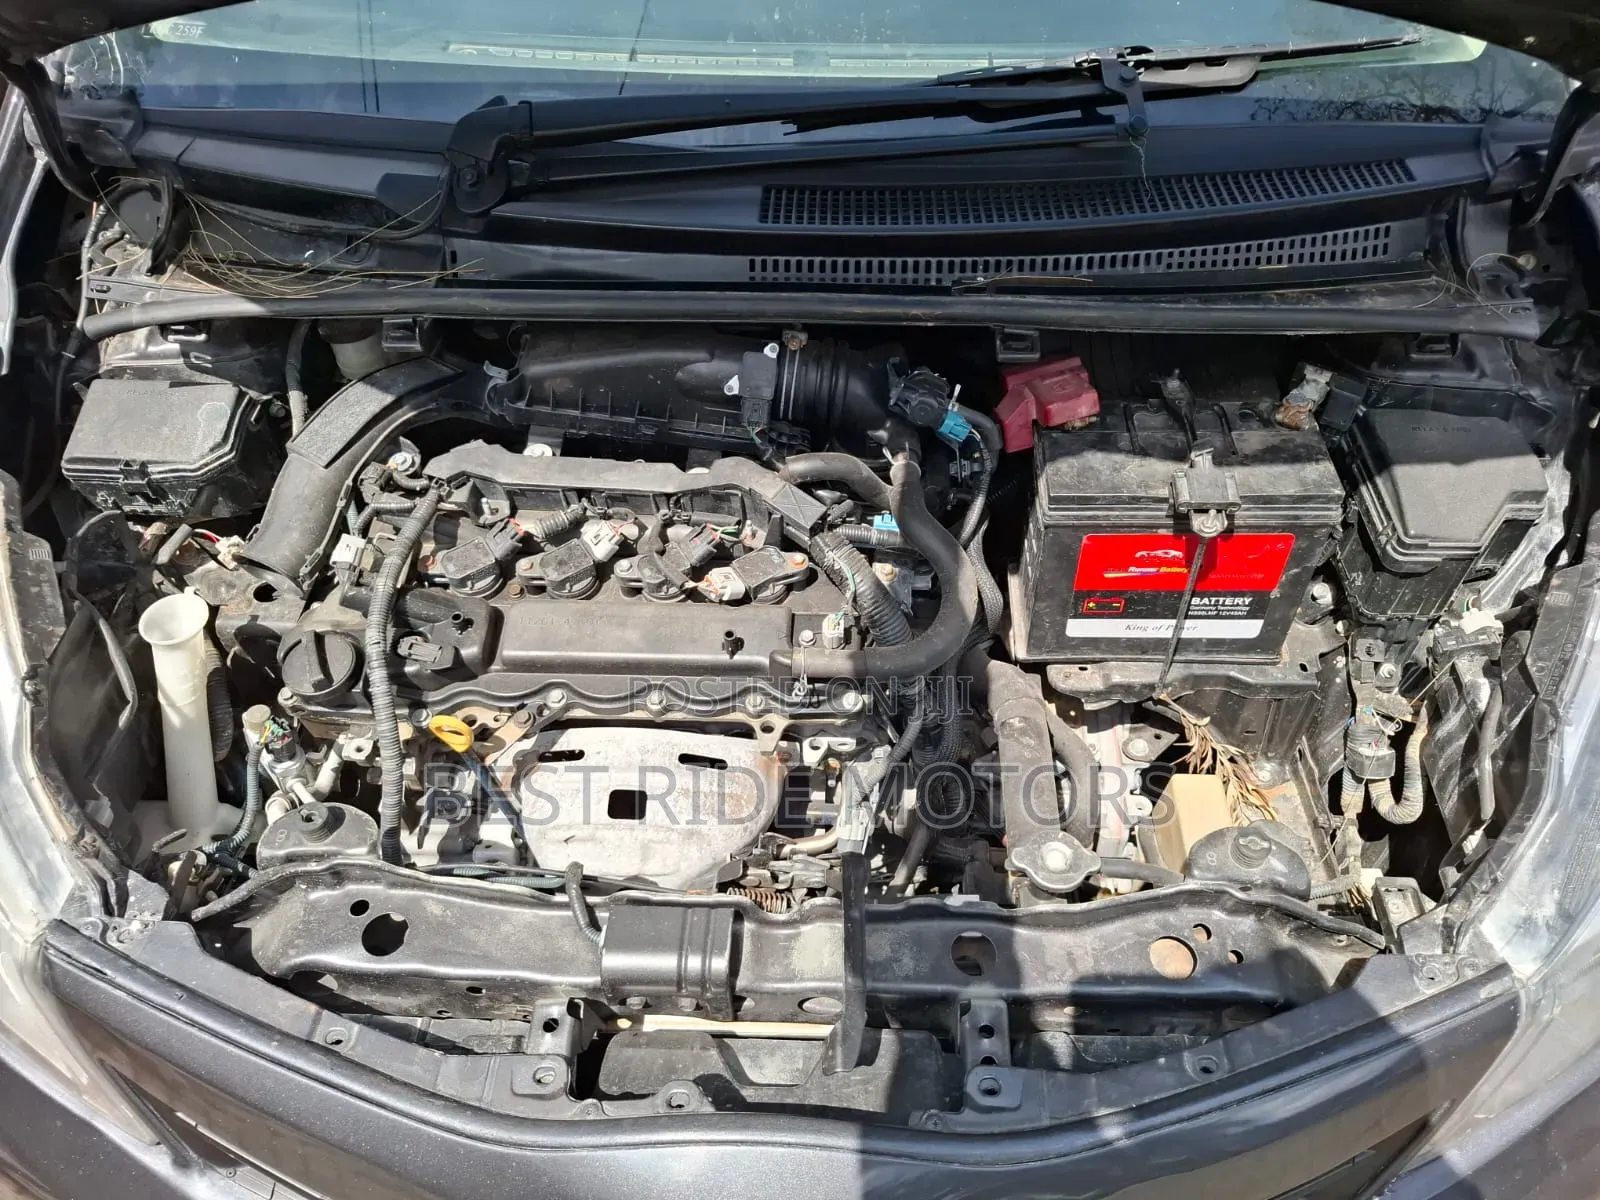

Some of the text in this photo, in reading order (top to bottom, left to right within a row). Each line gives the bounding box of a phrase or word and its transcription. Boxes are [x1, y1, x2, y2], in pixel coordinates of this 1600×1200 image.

[1190, 597, 1253, 606] BATTERY
[1124, 623, 1150, 633] King
[1152, 623, 1164, 633] of
